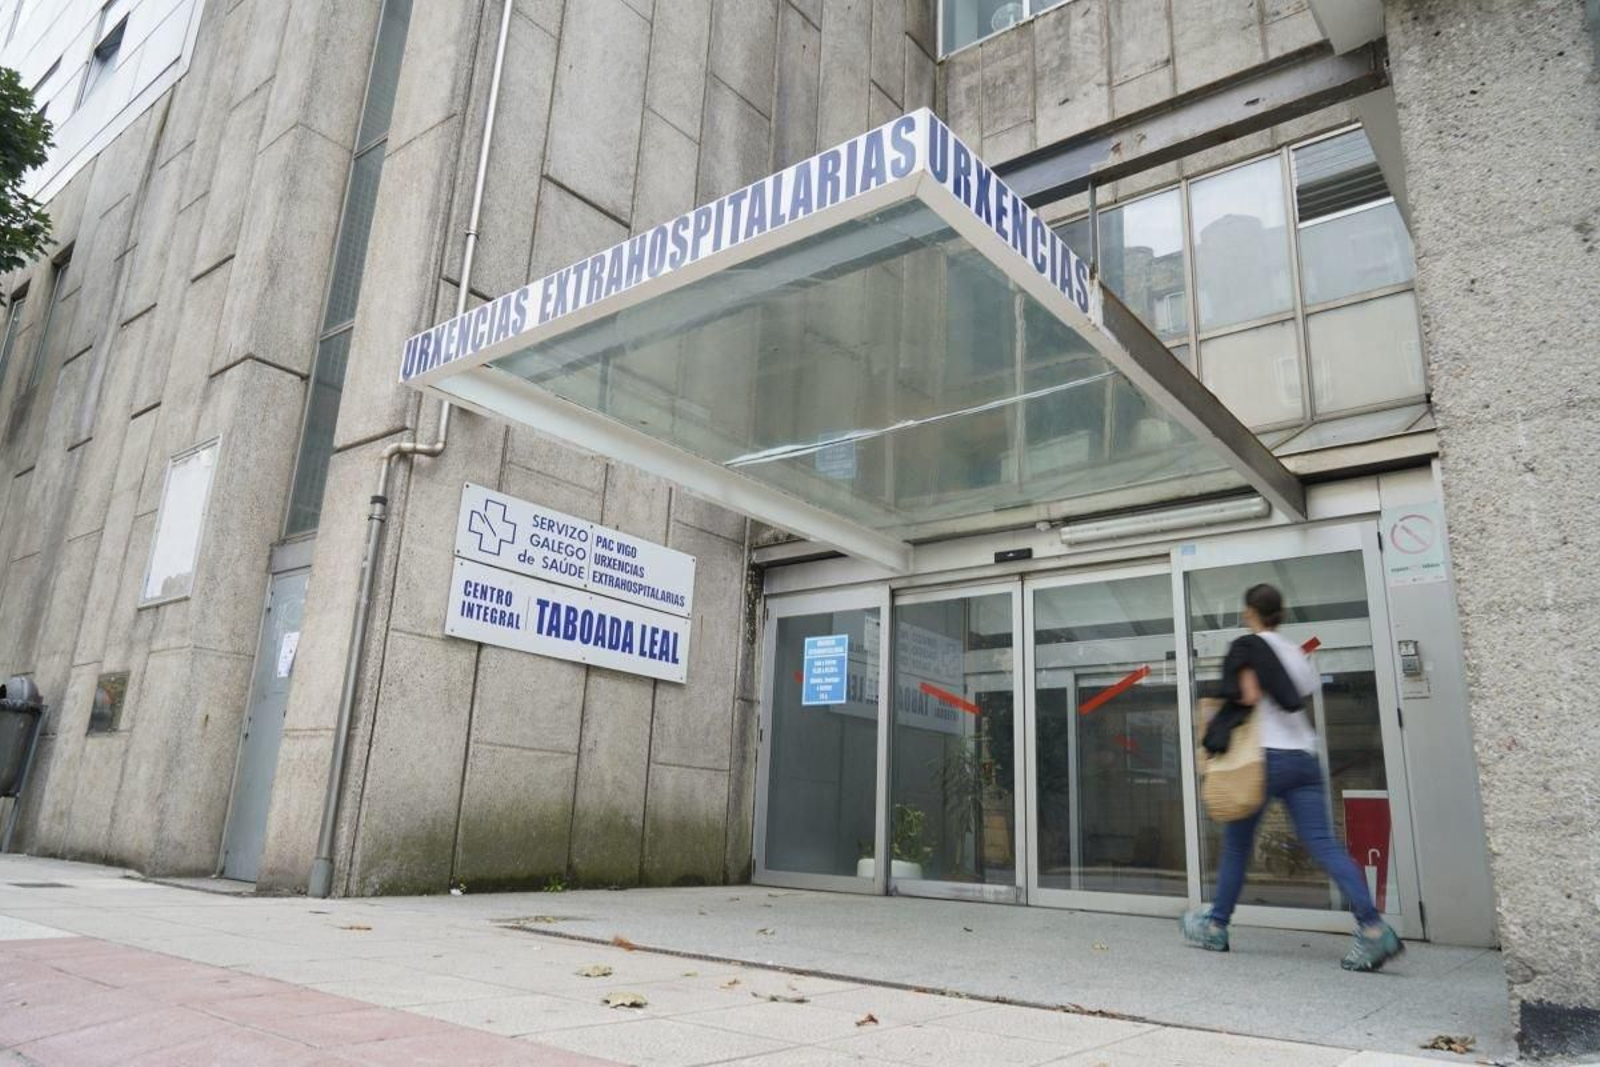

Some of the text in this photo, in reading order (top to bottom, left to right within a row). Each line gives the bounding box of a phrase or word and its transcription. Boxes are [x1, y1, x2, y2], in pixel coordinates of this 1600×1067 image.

[927, 112, 1090, 314] URXENCIAS
[402, 115, 917, 380] URXENCIAS EXTRAHOSPITALARIAS
[532, 514, 589, 543] SERVIZO
[529, 533, 587, 561] GALEGO
[596, 535, 637, 559] PAC VIGO
[517, 549, 585, 580] de SAÚDE
[594, 553, 645, 578] URXENCIAS
[463, 580, 513, 608] CENTRO
[592, 570, 685, 608] EXTRAHOSPITALARIAS
[460, 601, 521, 630] INTEGRAL
[536, 598, 680, 665] TABOADA LEAL
